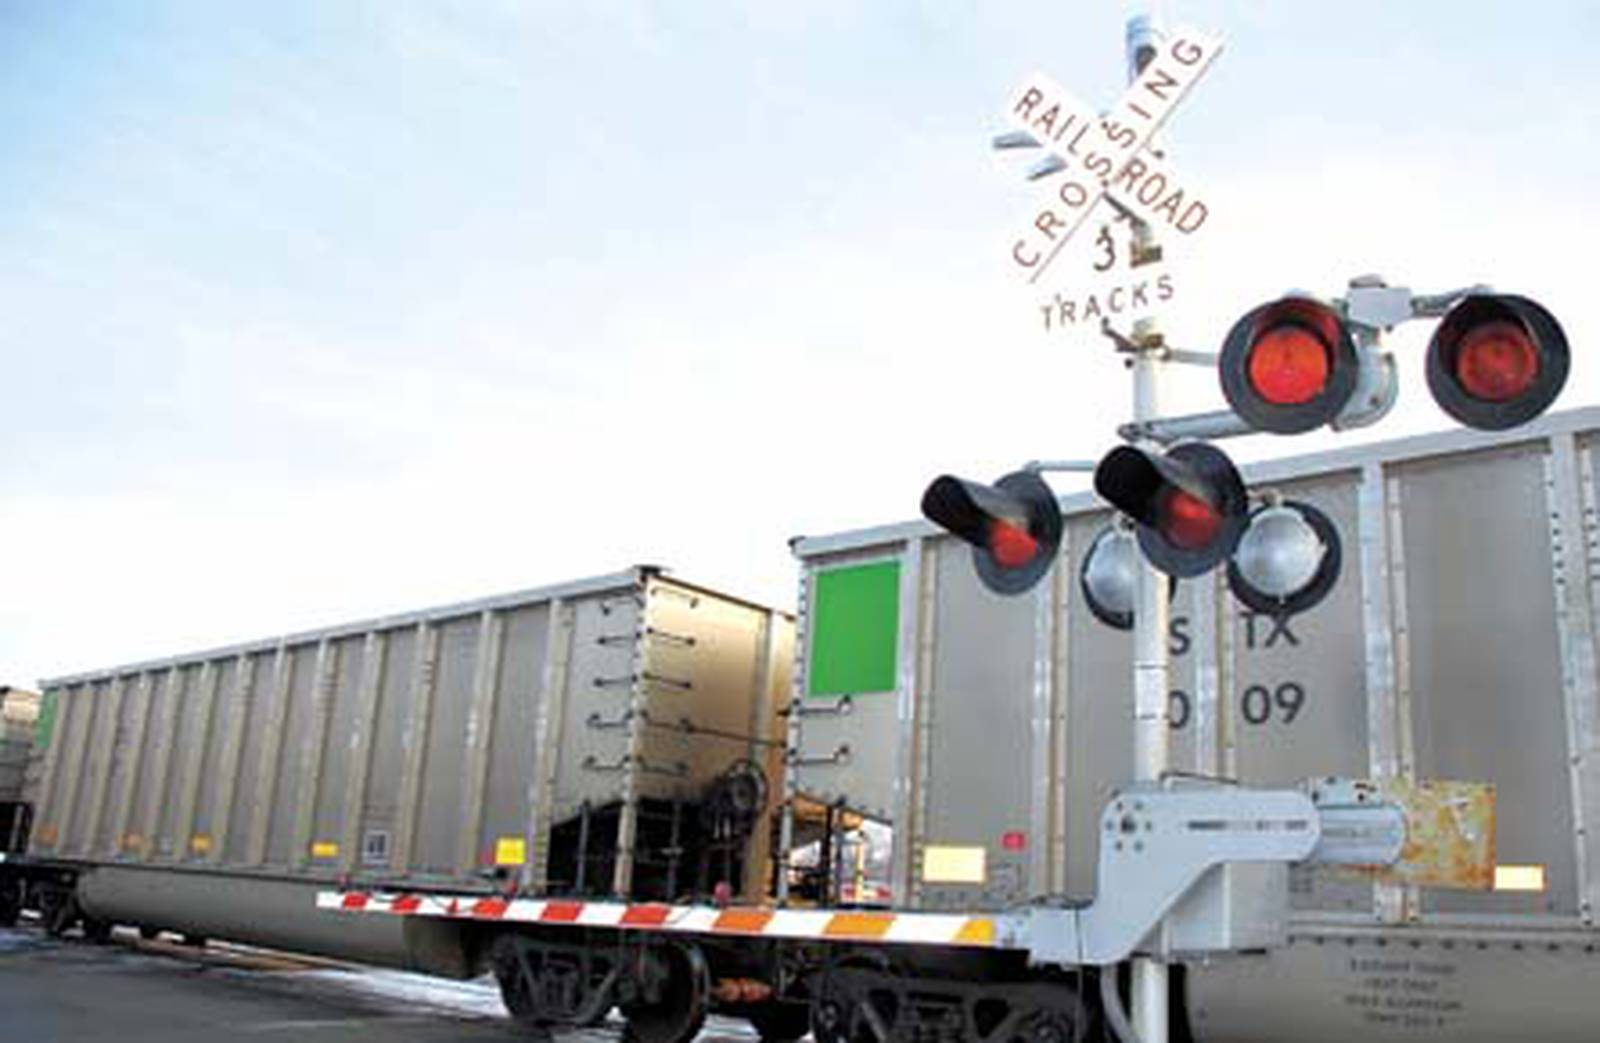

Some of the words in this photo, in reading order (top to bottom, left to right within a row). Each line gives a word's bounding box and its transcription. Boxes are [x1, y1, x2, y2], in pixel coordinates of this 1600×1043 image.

[1012, 38, 1202, 268] CROSSING
[1093, 231, 1116, 272] 3
[1040, 273, 1174, 331] TRACKS
[1242, 681, 1305, 725] 09
